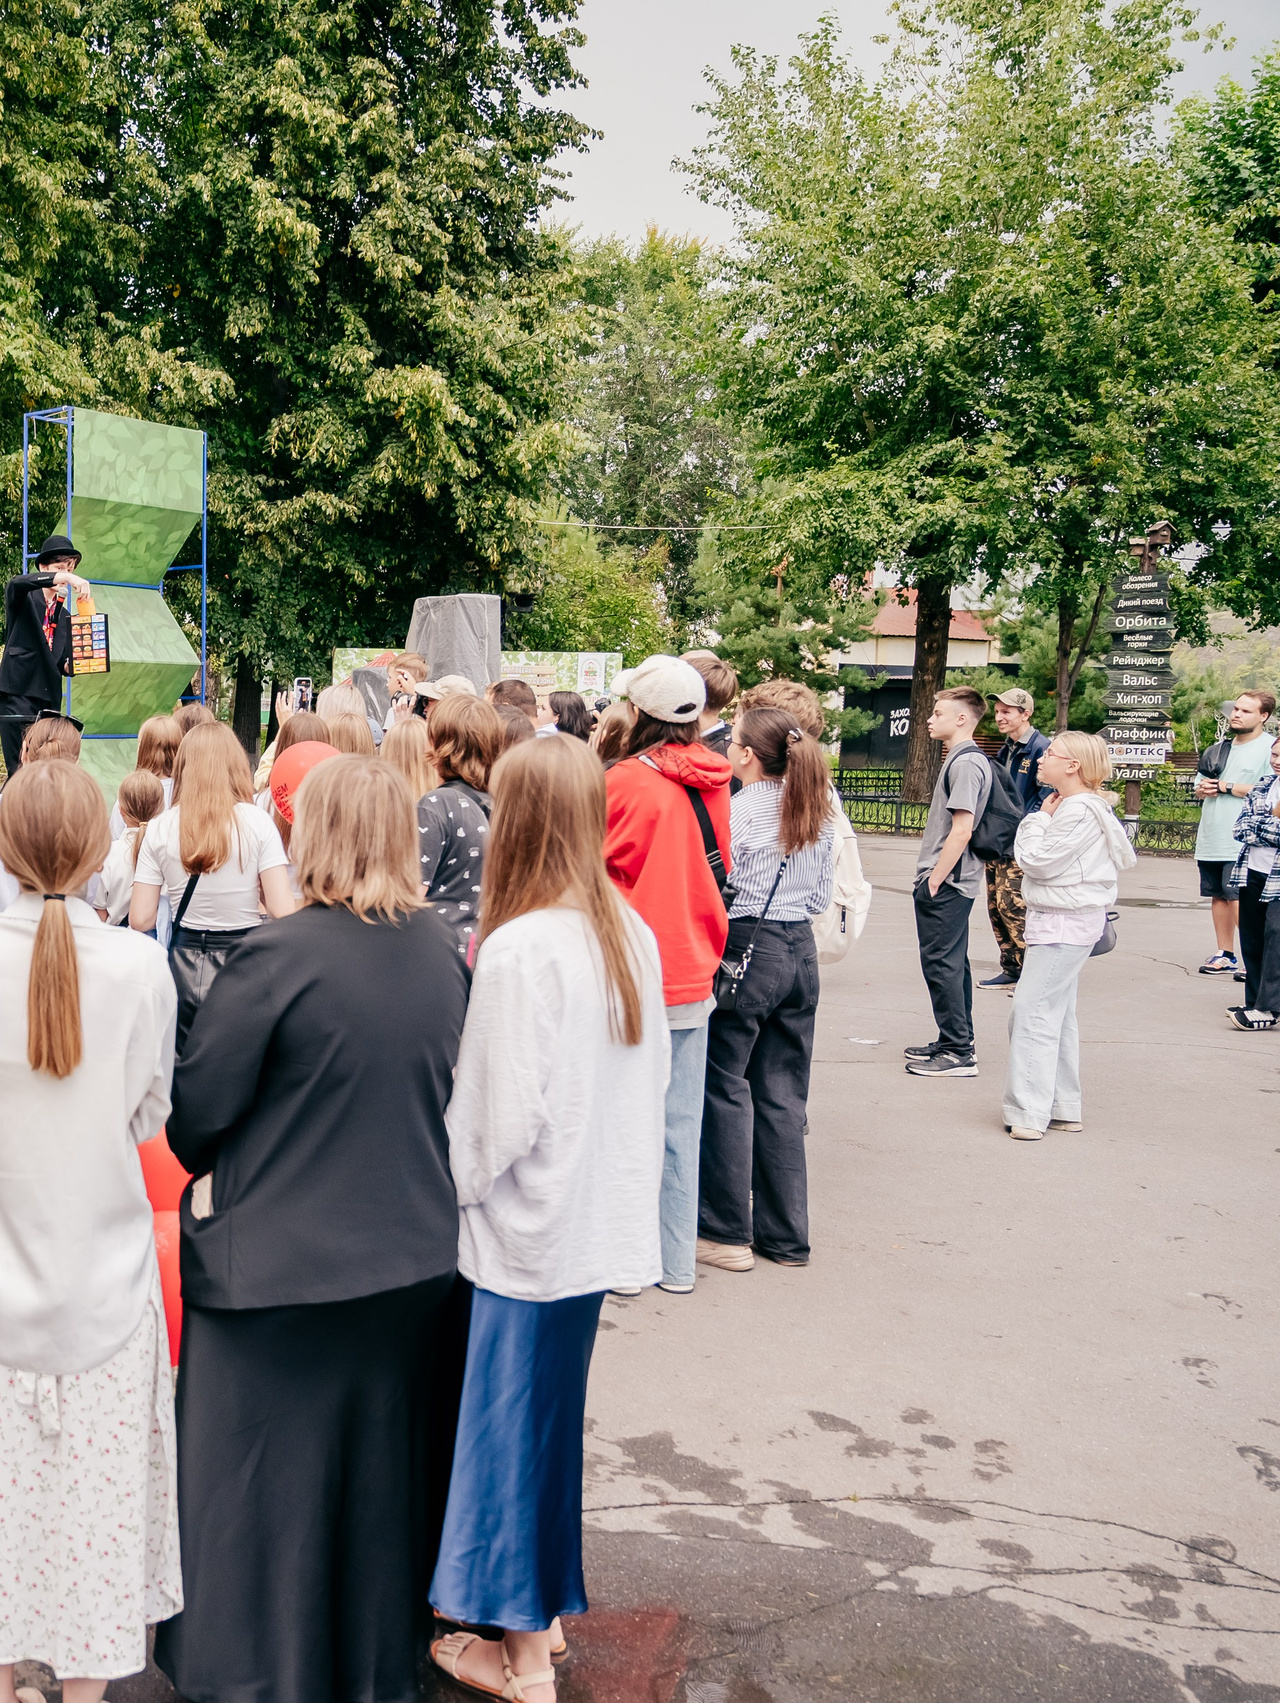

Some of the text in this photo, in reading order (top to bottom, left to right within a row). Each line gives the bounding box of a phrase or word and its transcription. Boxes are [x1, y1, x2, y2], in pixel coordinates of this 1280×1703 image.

[1117, 598, 1164, 608] Дикий поезд
[1115, 615, 1167, 629] Орбита
[1112, 655, 1164, 667] Рейнджер
[1123, 674, 1158, 686] Вальс
[1116, 692, 1162, 704] Хип-хоп
[890, 707, 910, 719] ЗАХО
[1108, 727, 1165, 740] Траффик
